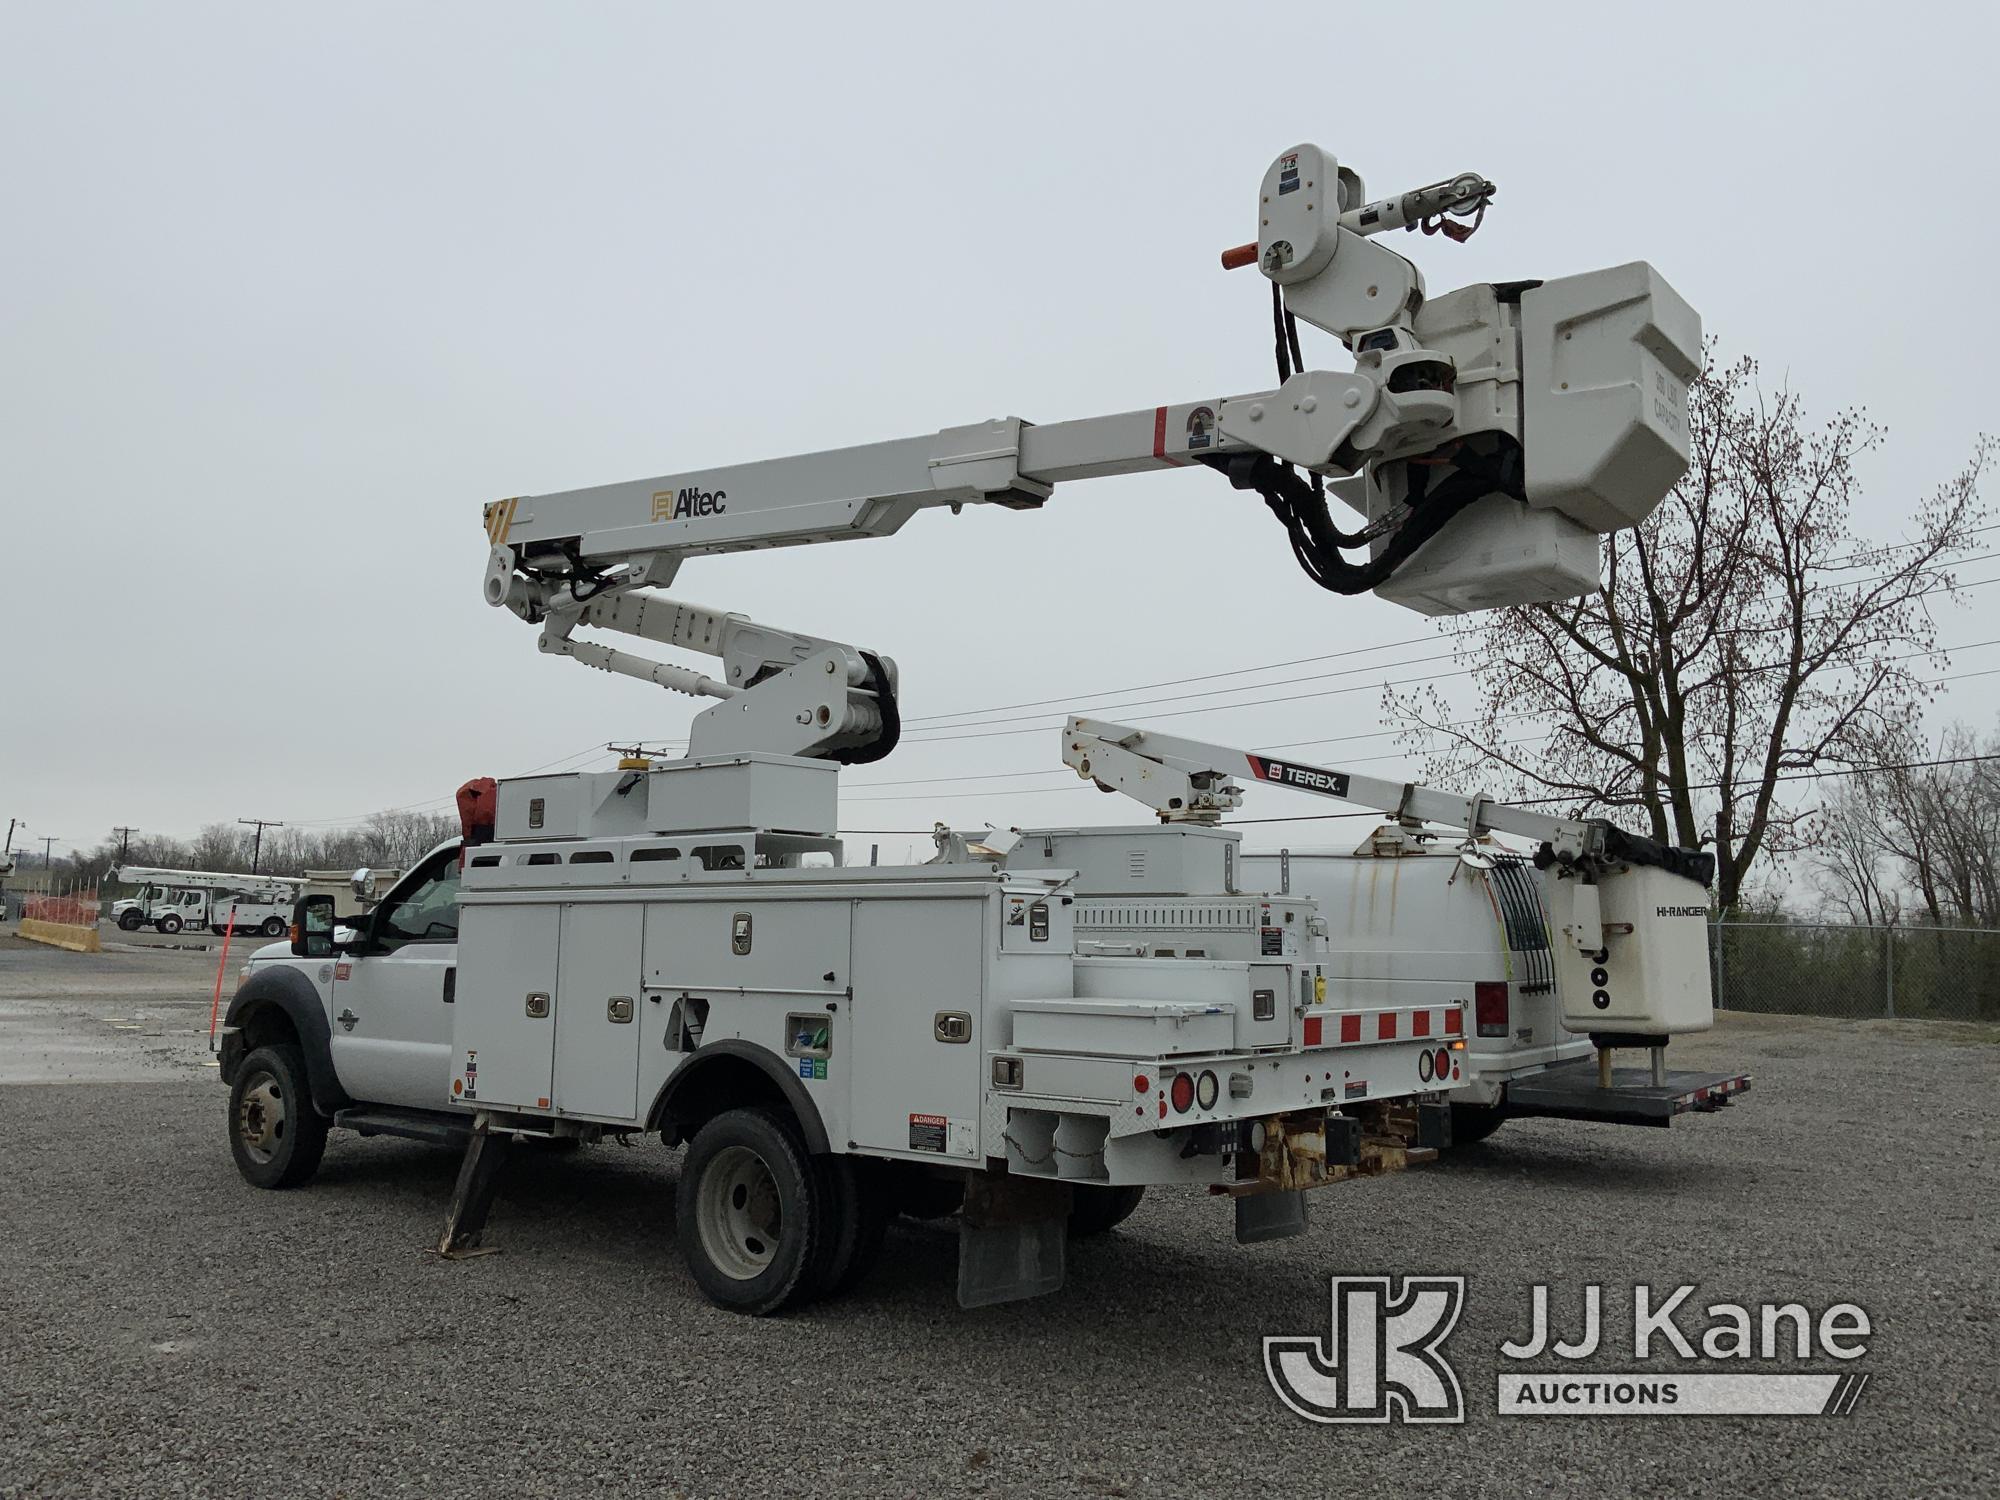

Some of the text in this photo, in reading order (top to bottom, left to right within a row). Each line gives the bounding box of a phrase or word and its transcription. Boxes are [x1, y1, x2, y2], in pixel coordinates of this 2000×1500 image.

[673, 487, 727, 519] Altec
[1286, 767, 1338, 791] TEREX
[1656, 906, 1707, 917] HI-RANGER
[919, 1115, 945, 1125] DANGER
